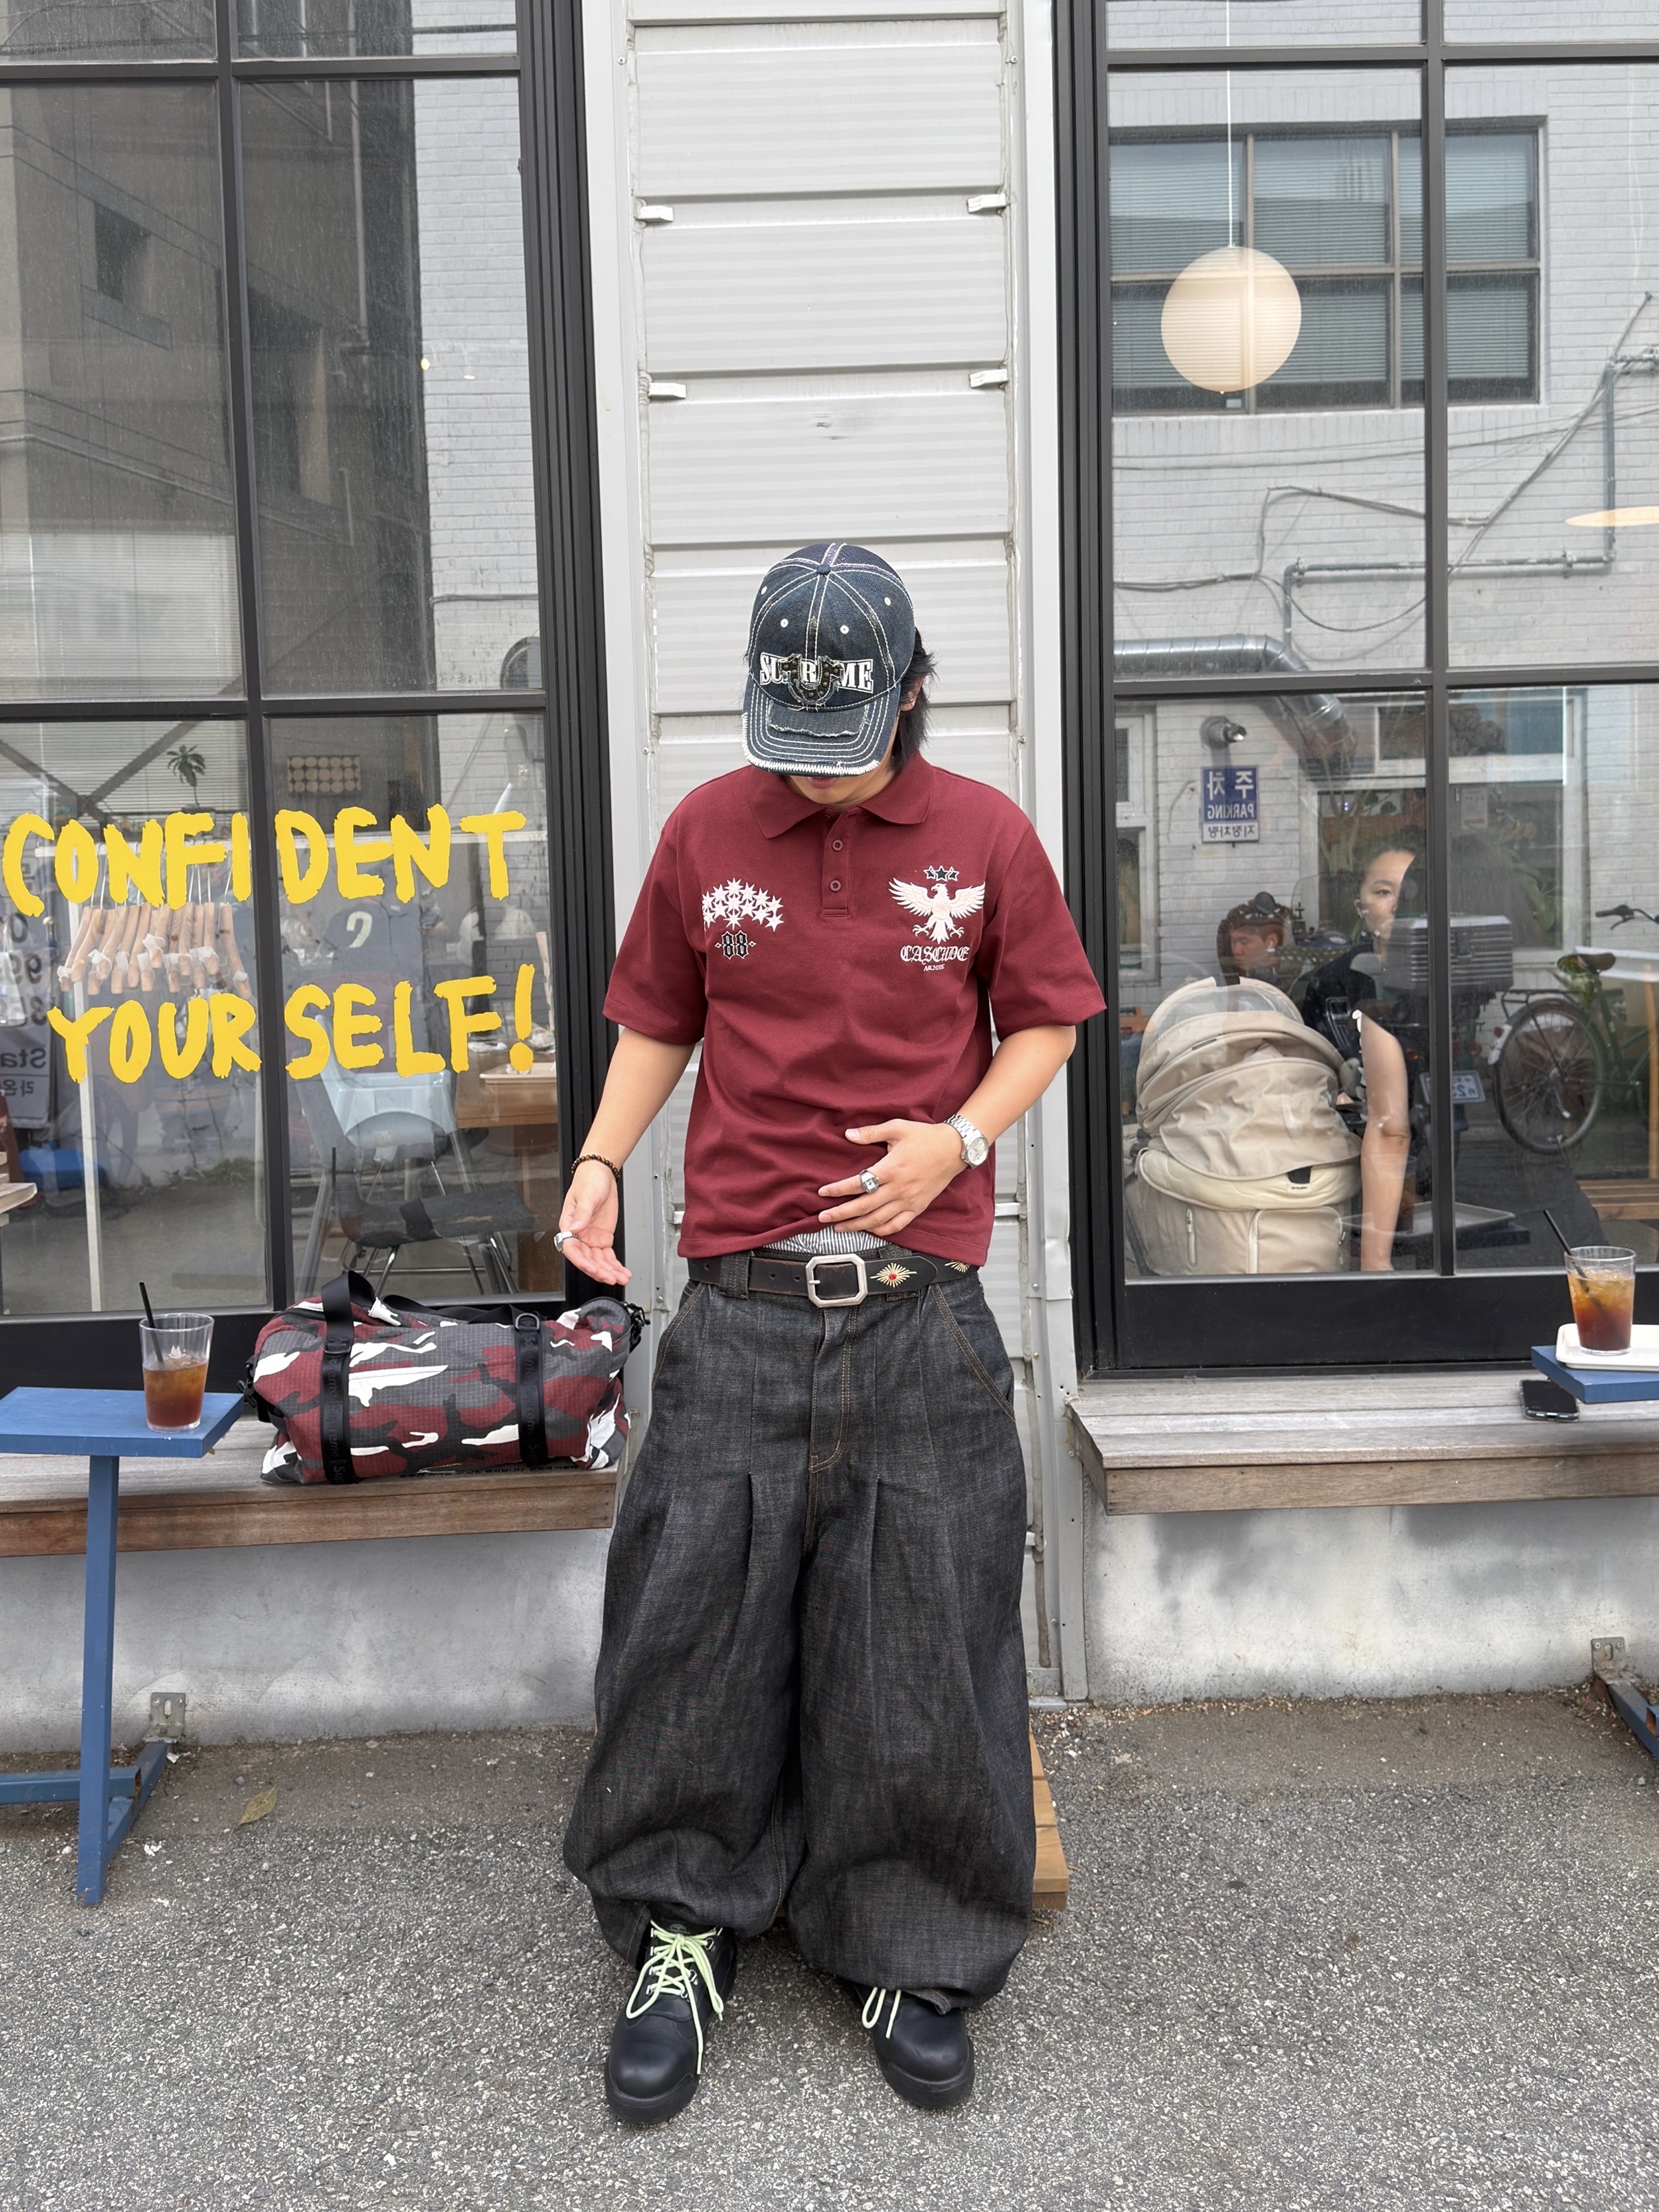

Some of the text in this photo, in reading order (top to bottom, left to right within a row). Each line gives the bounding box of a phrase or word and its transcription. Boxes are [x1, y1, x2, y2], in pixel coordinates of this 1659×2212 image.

[759, 652, 873, 693] SURME
[722, 930, 748, 960] 88
[47, 964, 534, 1083] YOUR SELF!
